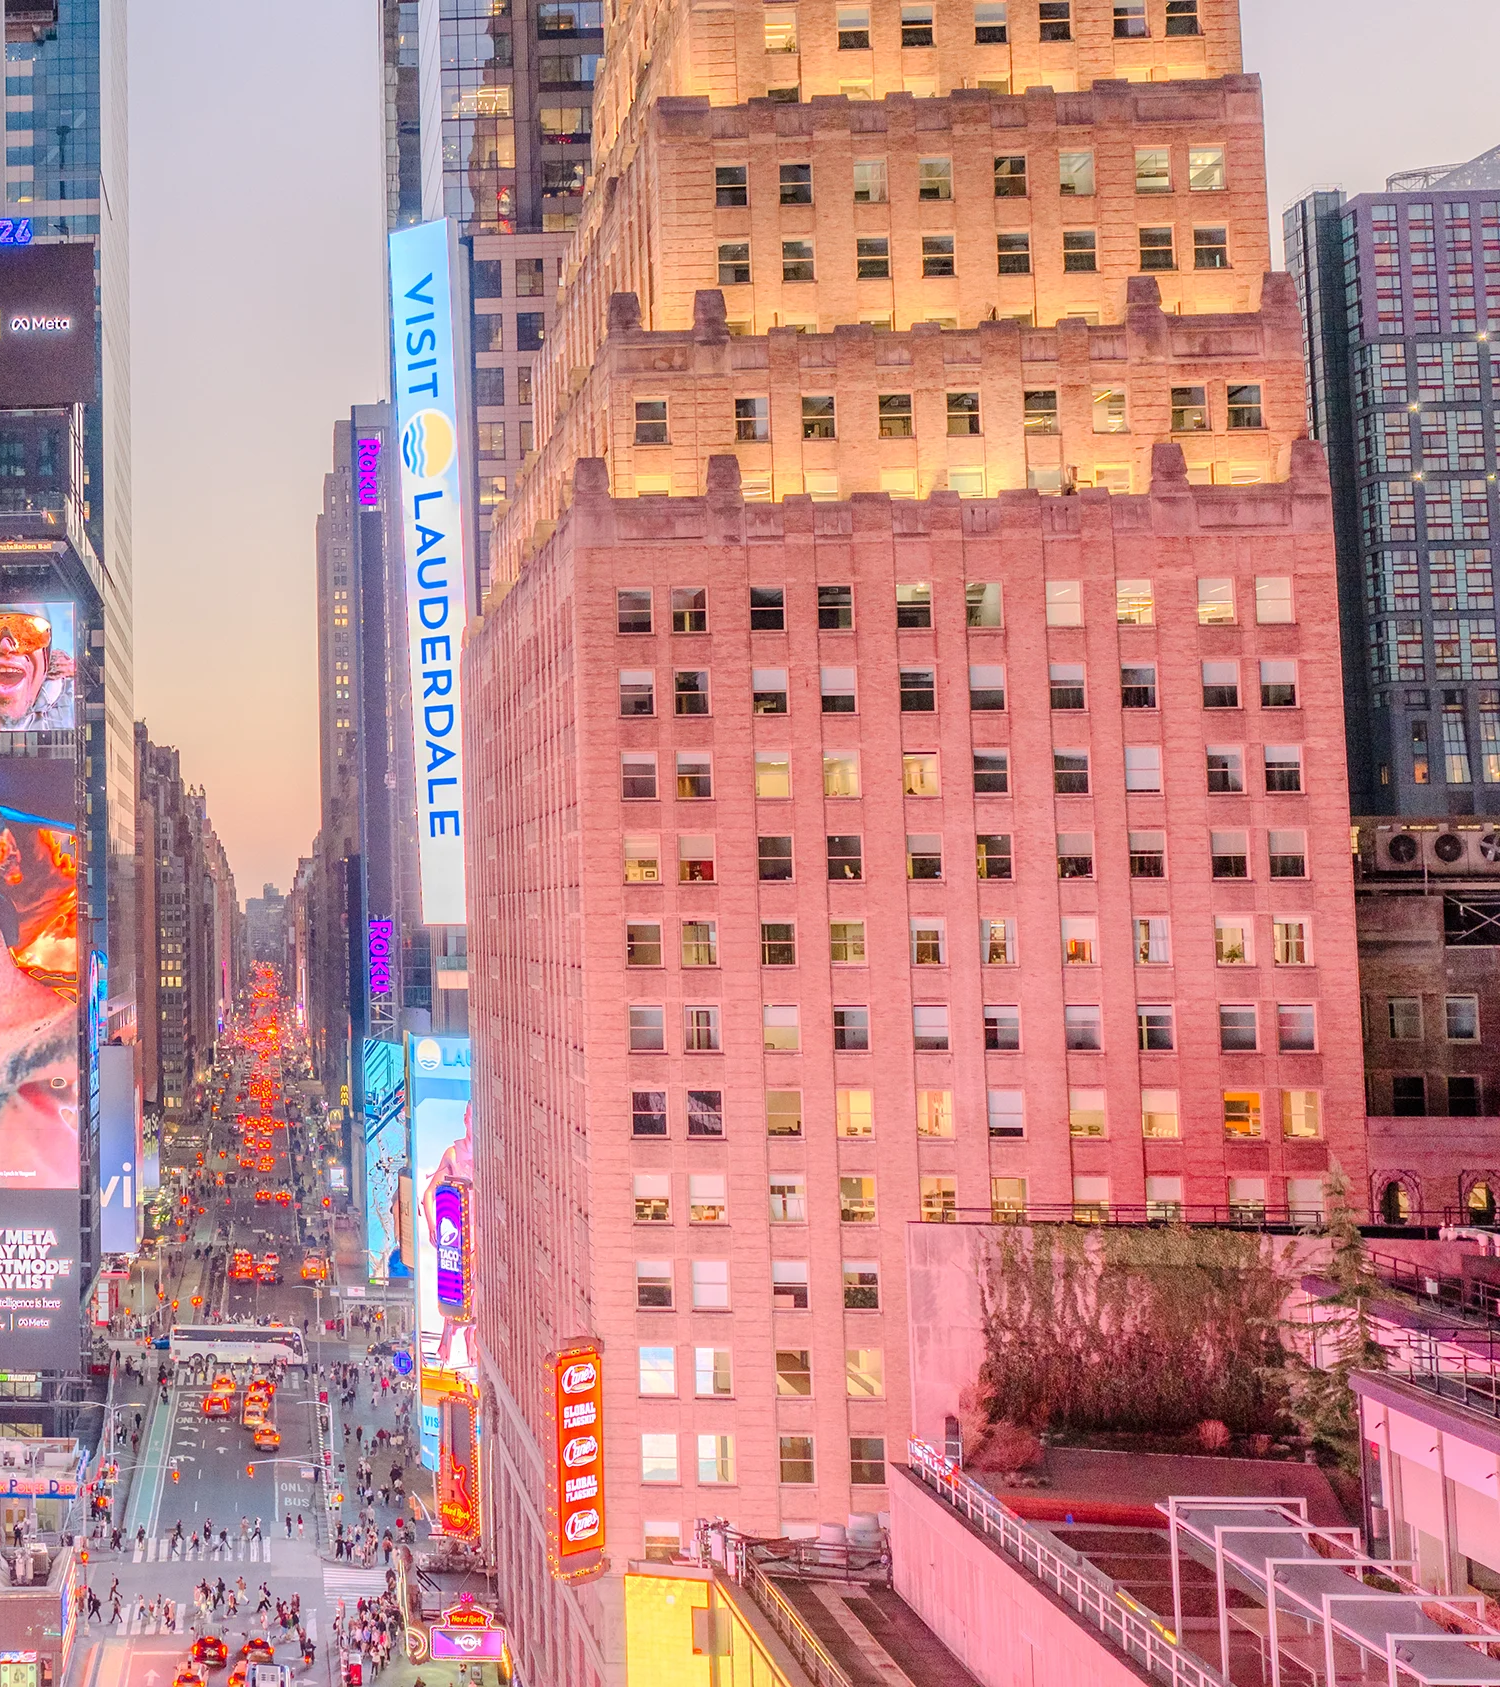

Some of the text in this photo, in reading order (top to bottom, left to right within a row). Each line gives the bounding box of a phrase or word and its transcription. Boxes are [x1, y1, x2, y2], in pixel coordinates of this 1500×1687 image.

[31, 316, 71, 331] Meta
[403, 271, 441, 398] VISIT
[413, 490, 460, 838] LAUDERDALE
[5, 1229, 58, 1245] META
[18, 1245, 51, 1259] MY
[438, 1248, 459, 1262] TACO
[440, 1259, 459, 1272] BELL
[35, 1297, 42, 1308] is
[42, 1297, 61, 1308] here
[29, 1319, 49, 1327] Meta
[178, 1401, 205, 1409] ONLY
[563, 1401, 596, 1419] GLOBAL
[176, 1416, 205, 1424] ONLY
[424, 1415, 439, 1428] VIS
[563, 1413, 596, 1429] FLAGSHIP
[49, 1480, 77, 1494] DEPT
[280, 1482, 311, 1493] ONLY
[565, 1474, 598, 1491] GLOBAL
[284, 1497, 310, 1507] BUS
[565, 1487, 598, 1503] FLAGSHIP
[442, 1503, 471, 1521] Hard Rock
[451, 1615, 485, 1625] Hard Rock
